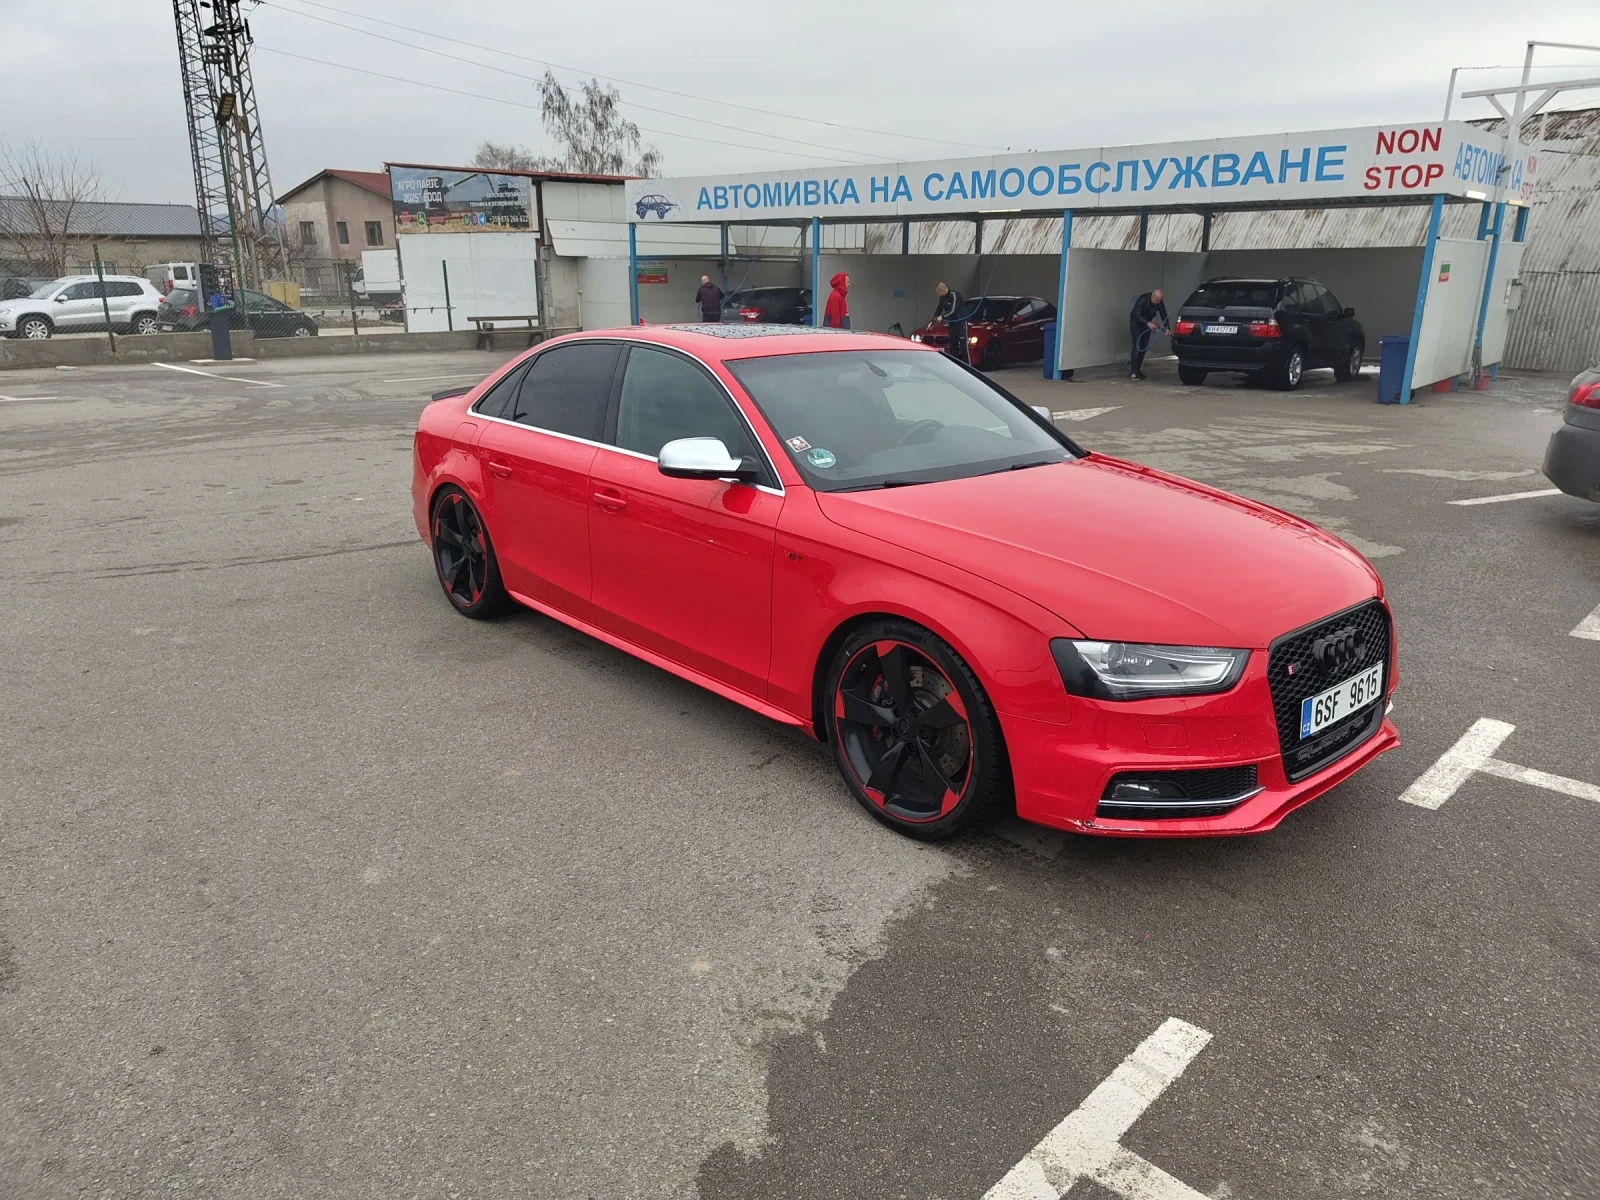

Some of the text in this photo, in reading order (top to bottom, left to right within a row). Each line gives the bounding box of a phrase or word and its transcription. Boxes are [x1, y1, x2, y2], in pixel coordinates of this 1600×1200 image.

[1375, 127, 1443, 155] NON
[696, 145, 1348, 211] АВТОМИВКА НА САМООБСЛУЖВАНЕ
[1363, 163, 1444, 190] STOP
[1452, 141, 1523, 191] АВТОМИКА
[1314, 669, 1379, 727] 6SF 9615
[1302, 722, 1310, 733] CZ
